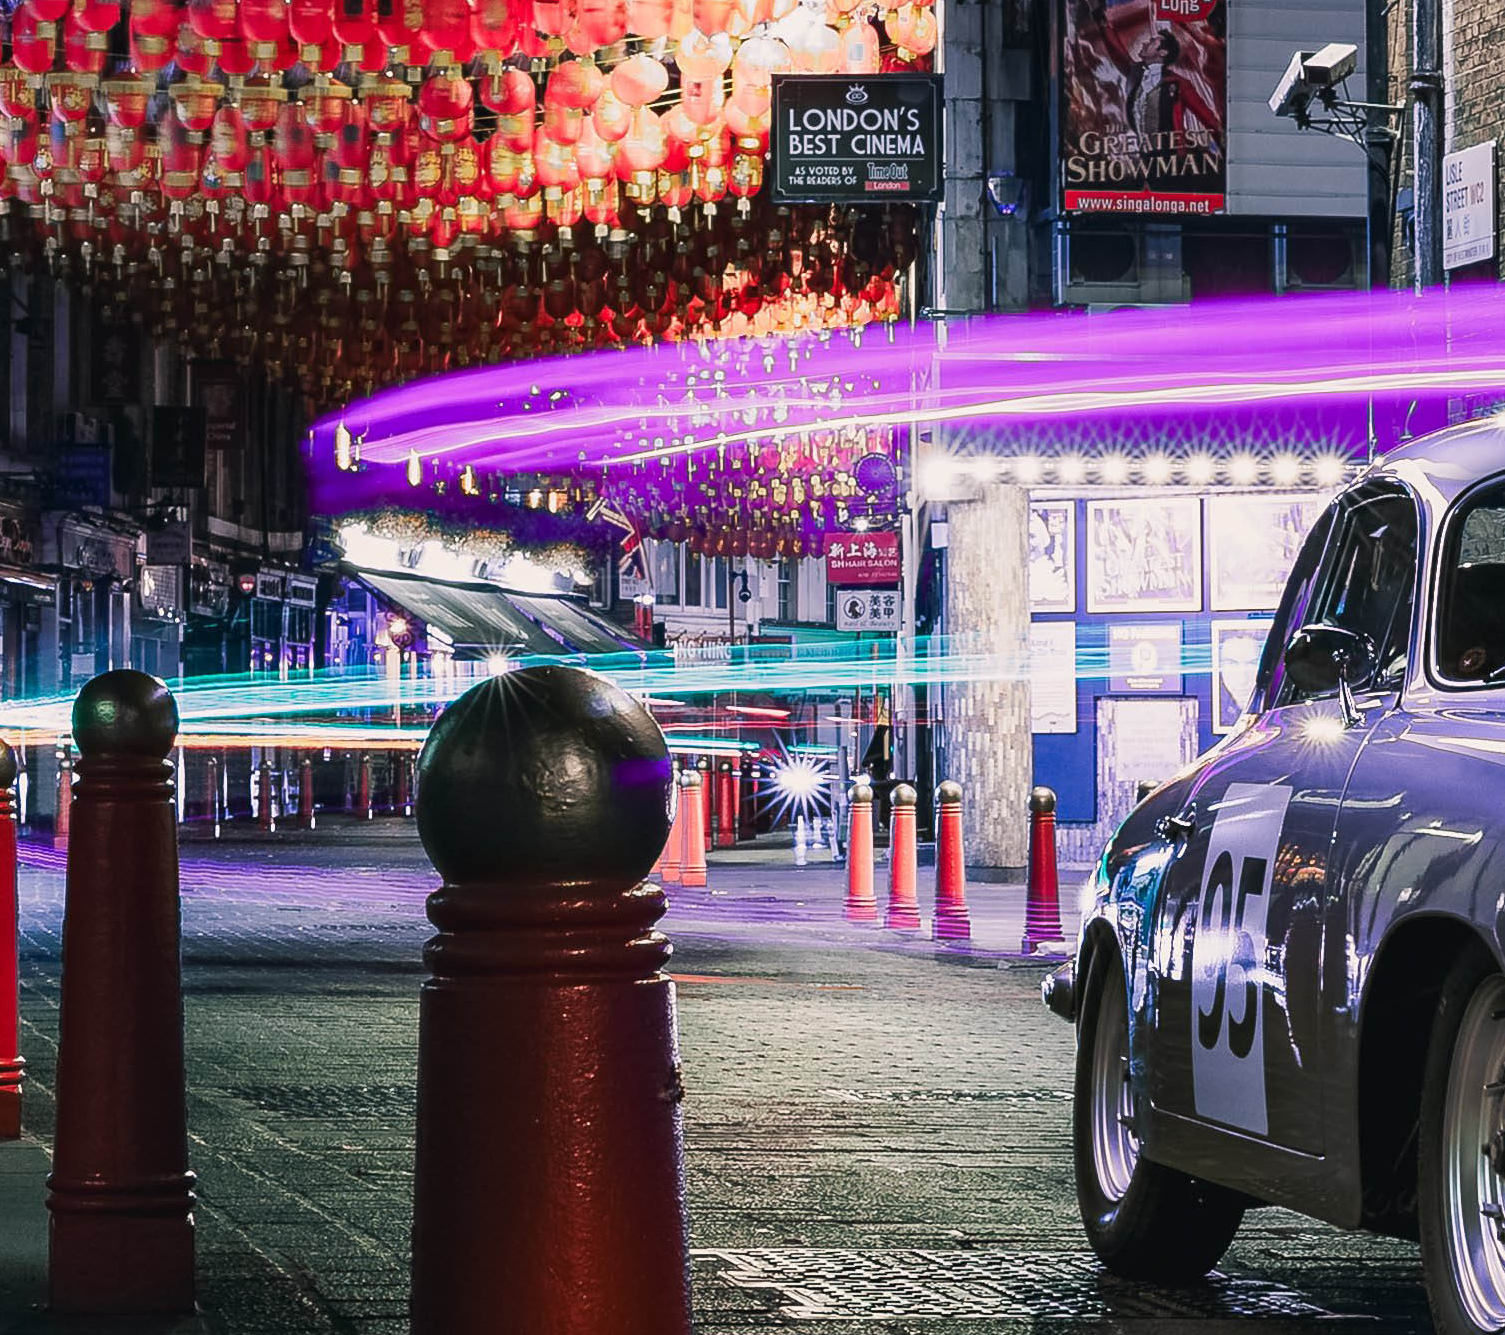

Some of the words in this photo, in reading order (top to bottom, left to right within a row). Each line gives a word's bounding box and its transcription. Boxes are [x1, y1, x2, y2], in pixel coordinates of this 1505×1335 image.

[789, 106, 920, 132] LONDON'S
[789, 134, 842, 155] BEST
[850, 134, 926, 155] CINEMA
[1079, 128, 1215, 156] GREATEST
[794, 166, 807, 176] AS
[808, 166, 840, 176] VOTED
[842, 166, 854, 176] BY
[1067, 152, 1222, 183] SHOWMAN
[788, 176, 804, 186] THE
[806, 176, 842, 186] READERS
[844, 176, 858, 186] OF
[872, 181, 902, 191] London
[1077, 195, 1211, 214] www.singalonga.net
[1446, 185, 1469, 214] STREET
[867, 558, 898, 568] SALON
[1197, 849, 1268, 1059] 95
